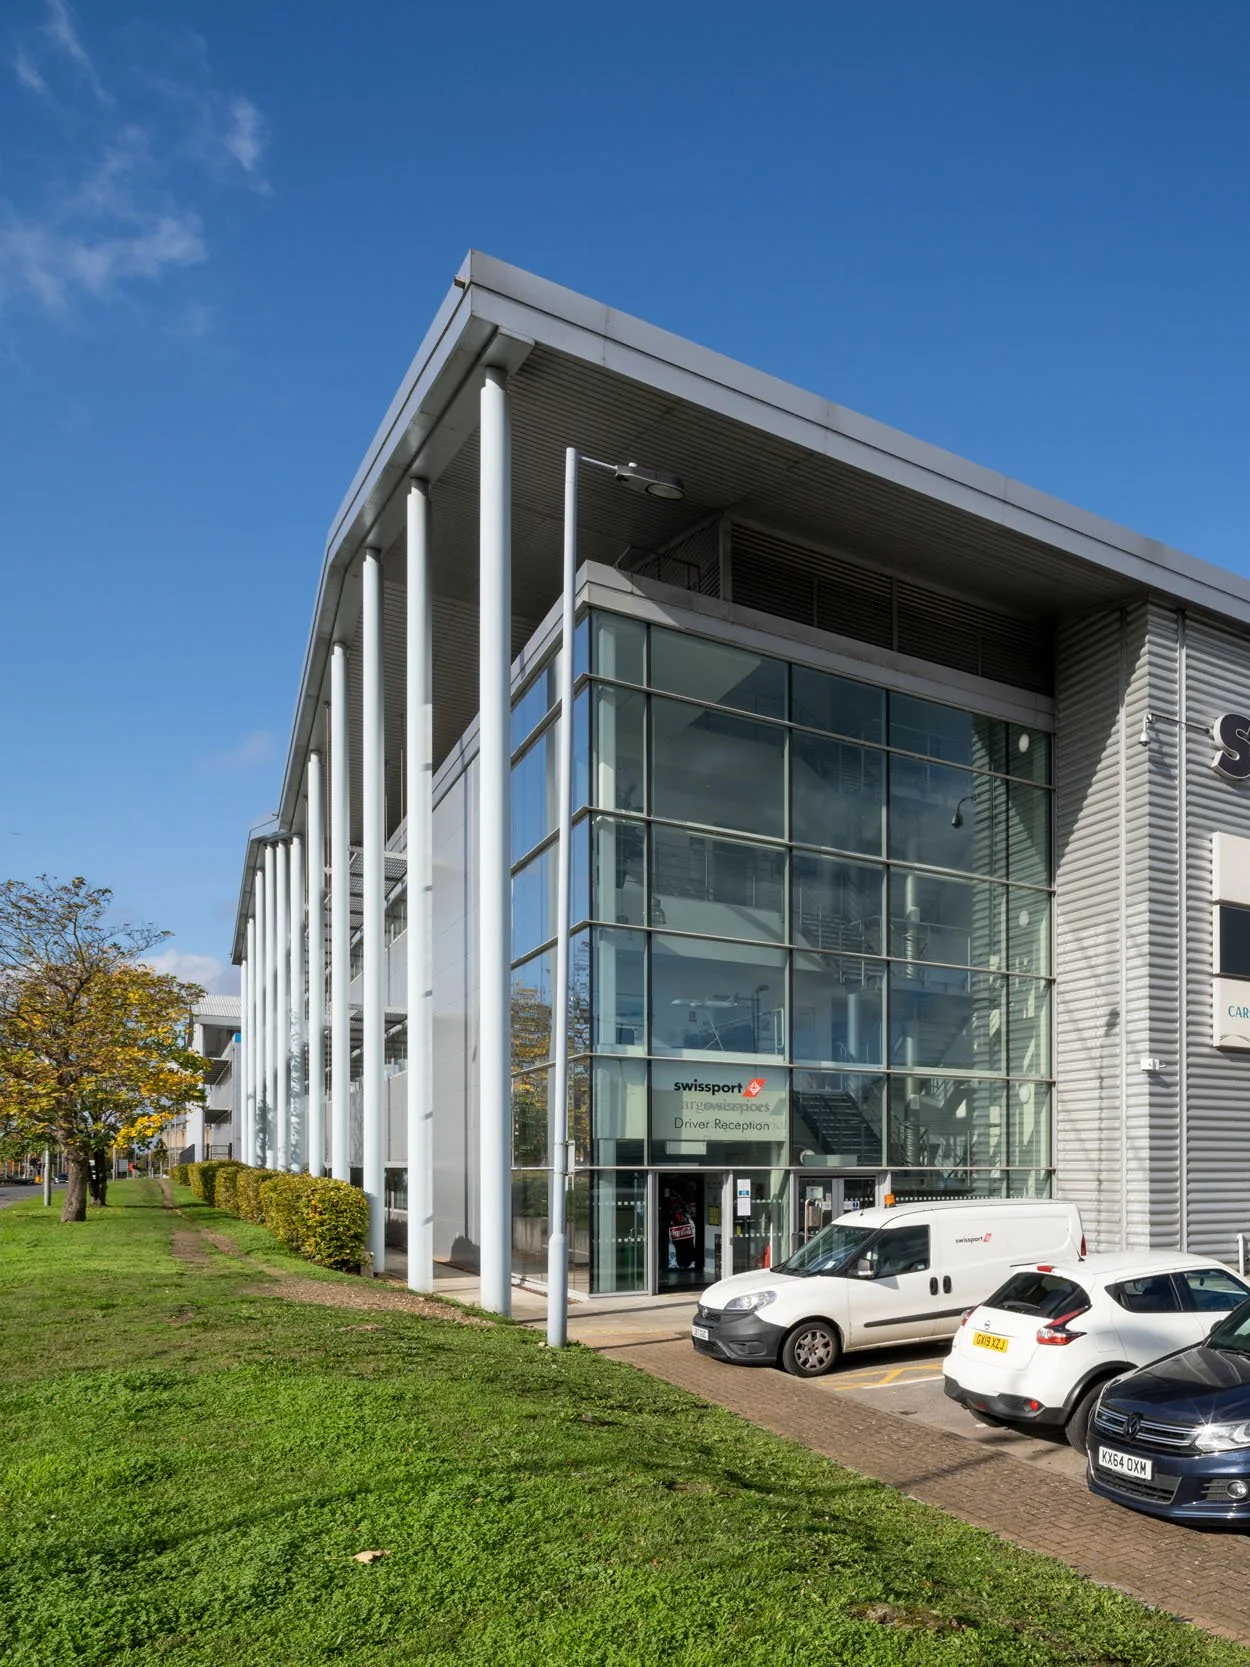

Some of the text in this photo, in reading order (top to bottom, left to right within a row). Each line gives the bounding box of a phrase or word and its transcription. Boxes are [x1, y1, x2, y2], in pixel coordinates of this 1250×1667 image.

[673, 1079, 743, 1096] swissport
[674, 1116, 770, 1133] Driver Reception
[1101, 1449, 1147, 1476] KX64 OXM
